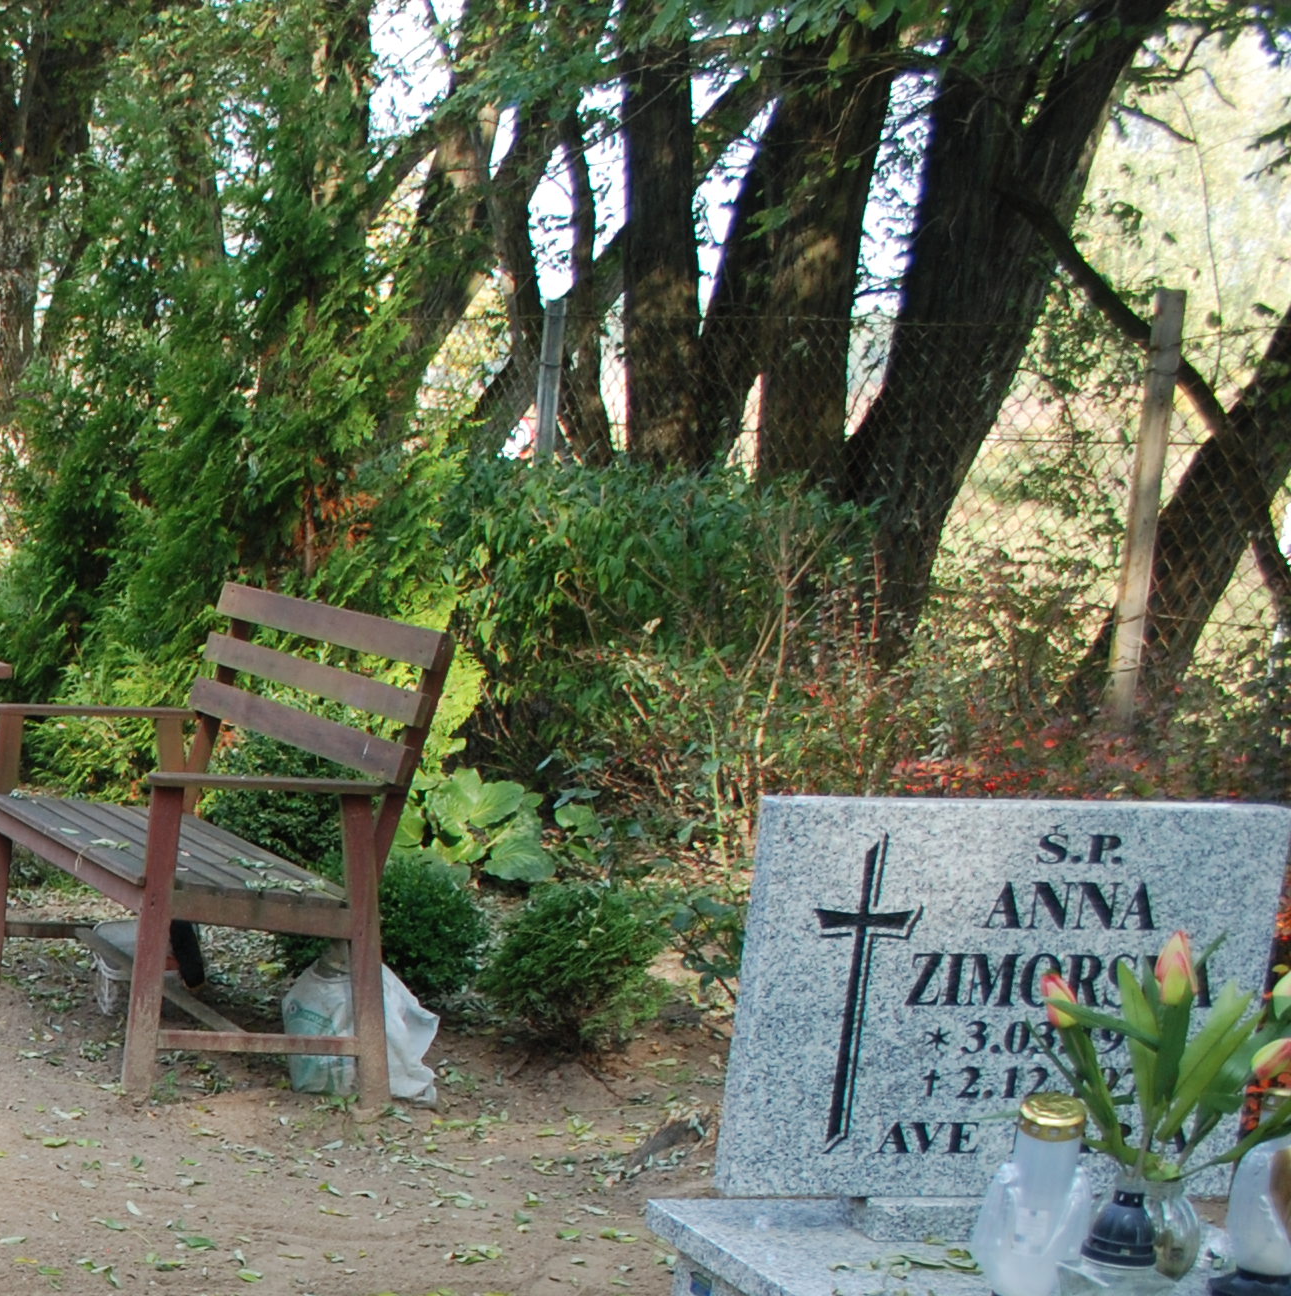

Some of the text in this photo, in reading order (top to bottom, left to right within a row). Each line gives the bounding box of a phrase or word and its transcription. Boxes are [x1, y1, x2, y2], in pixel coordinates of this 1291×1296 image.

[1035, 825, 1123, 866] Ś.P.
[981, 880, 1157, 931] ANNA
[878, 1120, 979, 1155] AVE
